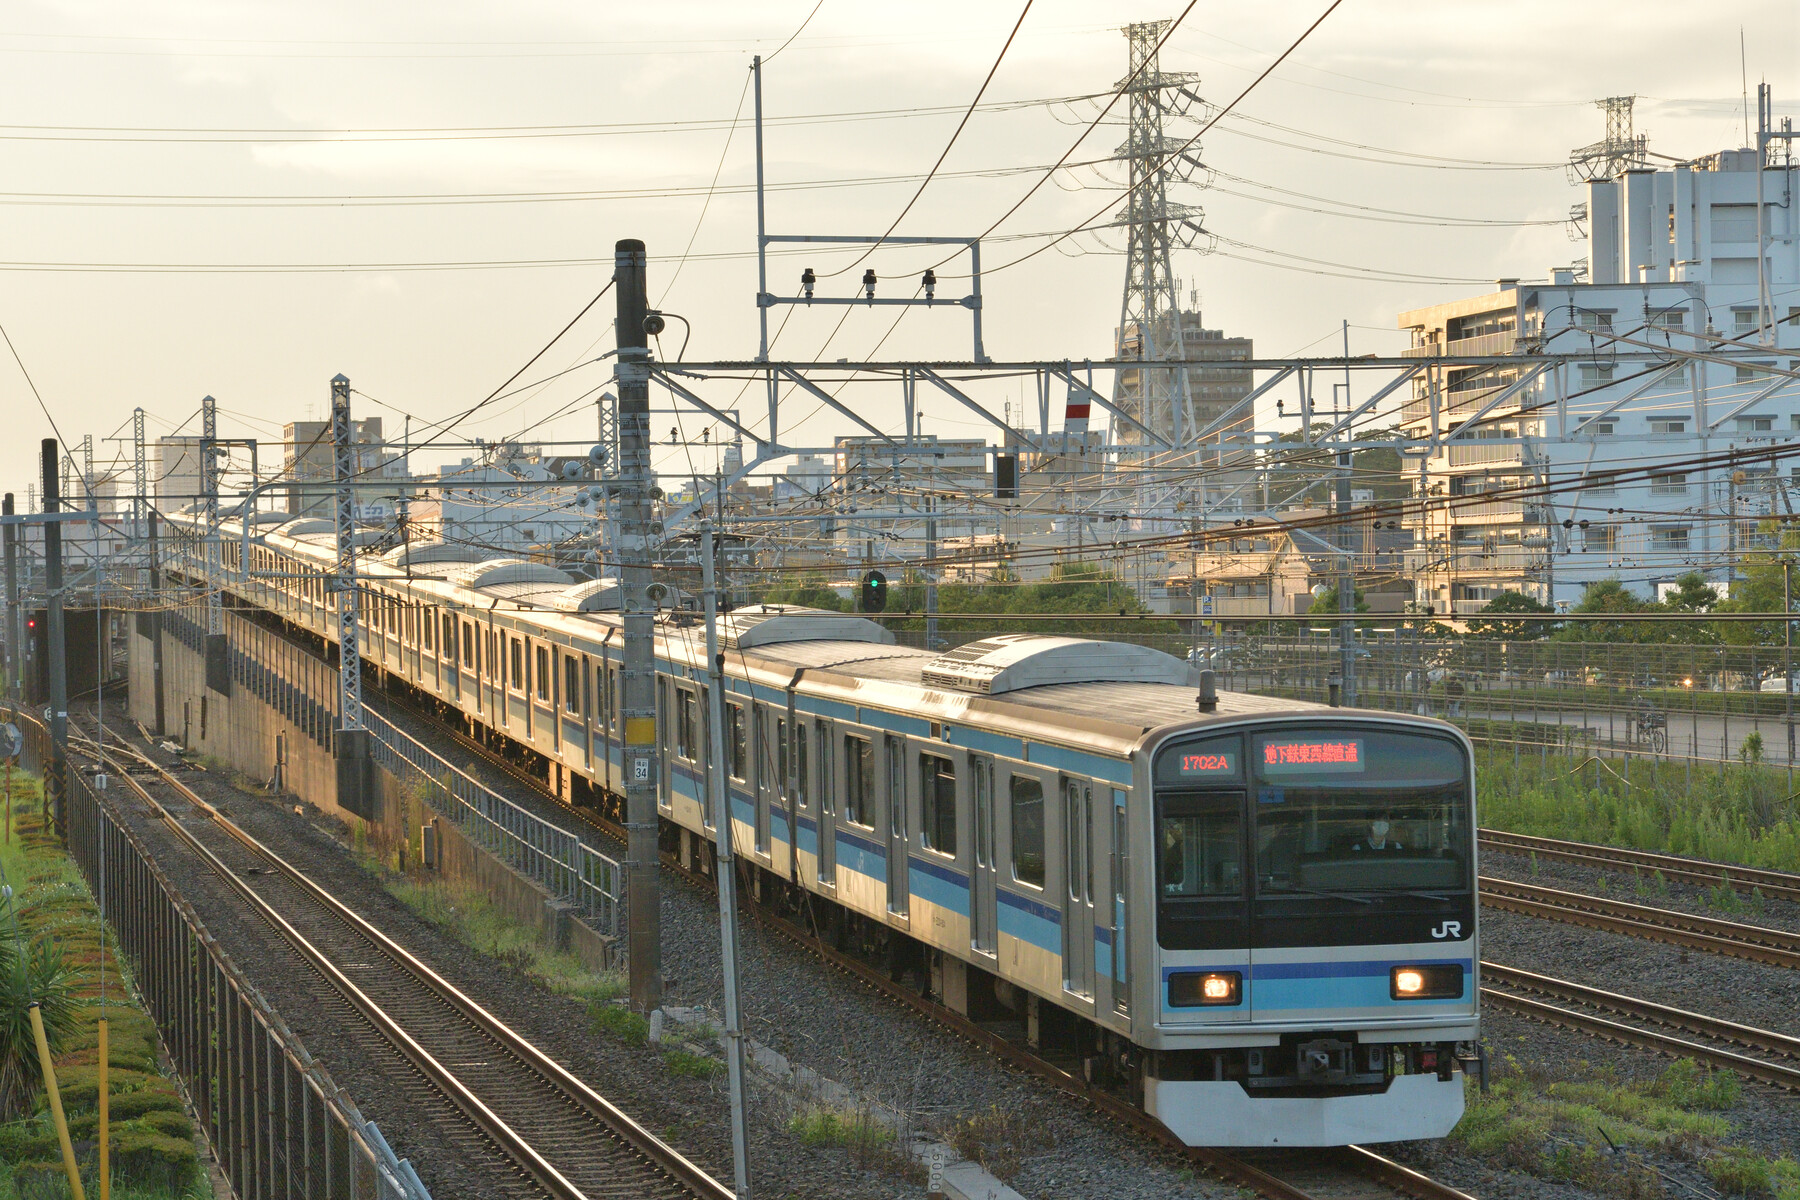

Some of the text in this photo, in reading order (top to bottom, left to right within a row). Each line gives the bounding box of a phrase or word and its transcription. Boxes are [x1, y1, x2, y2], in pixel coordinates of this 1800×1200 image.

[1264, 742, 1358, 764] 地下鉄東西線直通
[1183, 755, 1229, 770] 1702A
[635, 767, 647, 778] 34
[1431, 920, 1461, 938] JR
[931, 1153, 943, 1190] 5000
